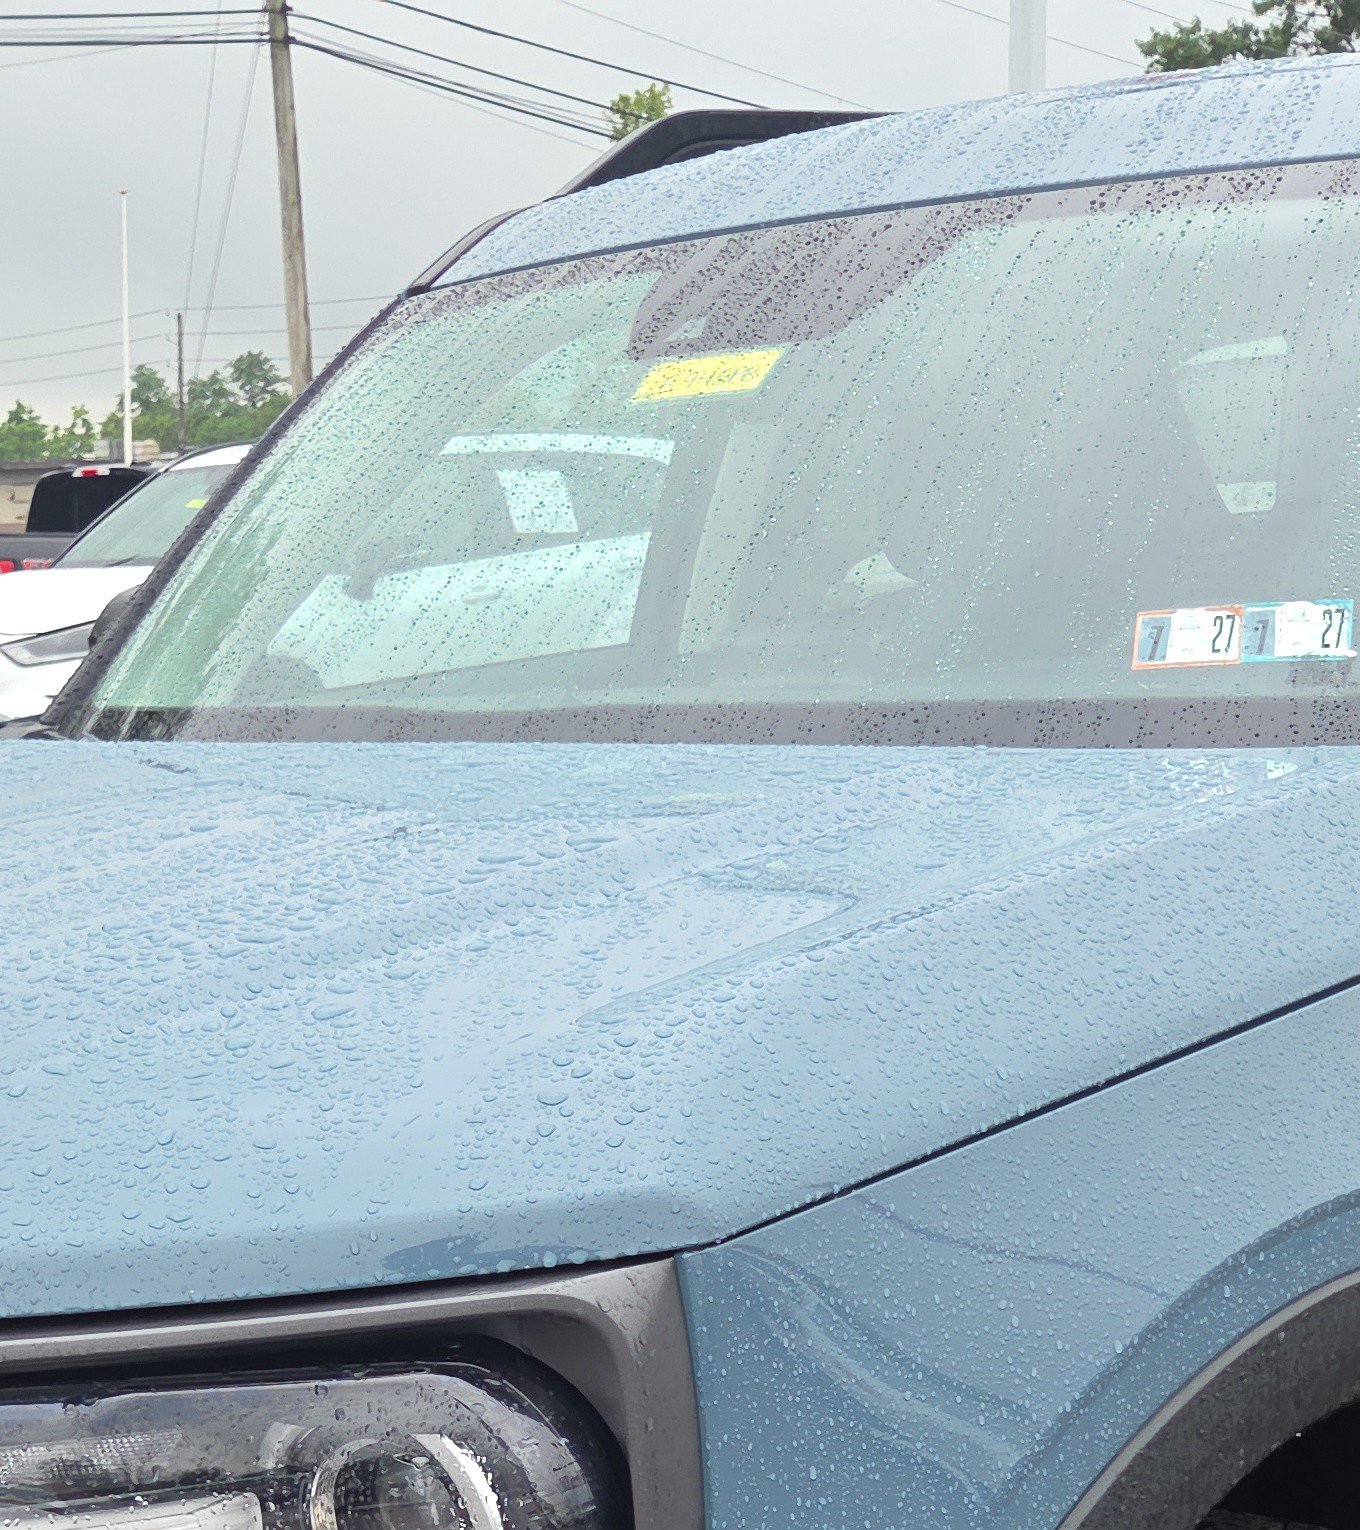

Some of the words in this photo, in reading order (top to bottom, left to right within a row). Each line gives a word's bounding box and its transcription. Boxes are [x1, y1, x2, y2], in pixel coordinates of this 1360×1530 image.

[1147, 625, 1165, 661] 7
[1211, 614, 1236, 654] 27
[1255, 619, 1270, 656] 7
[1320, 607, 1346, 649] 27
